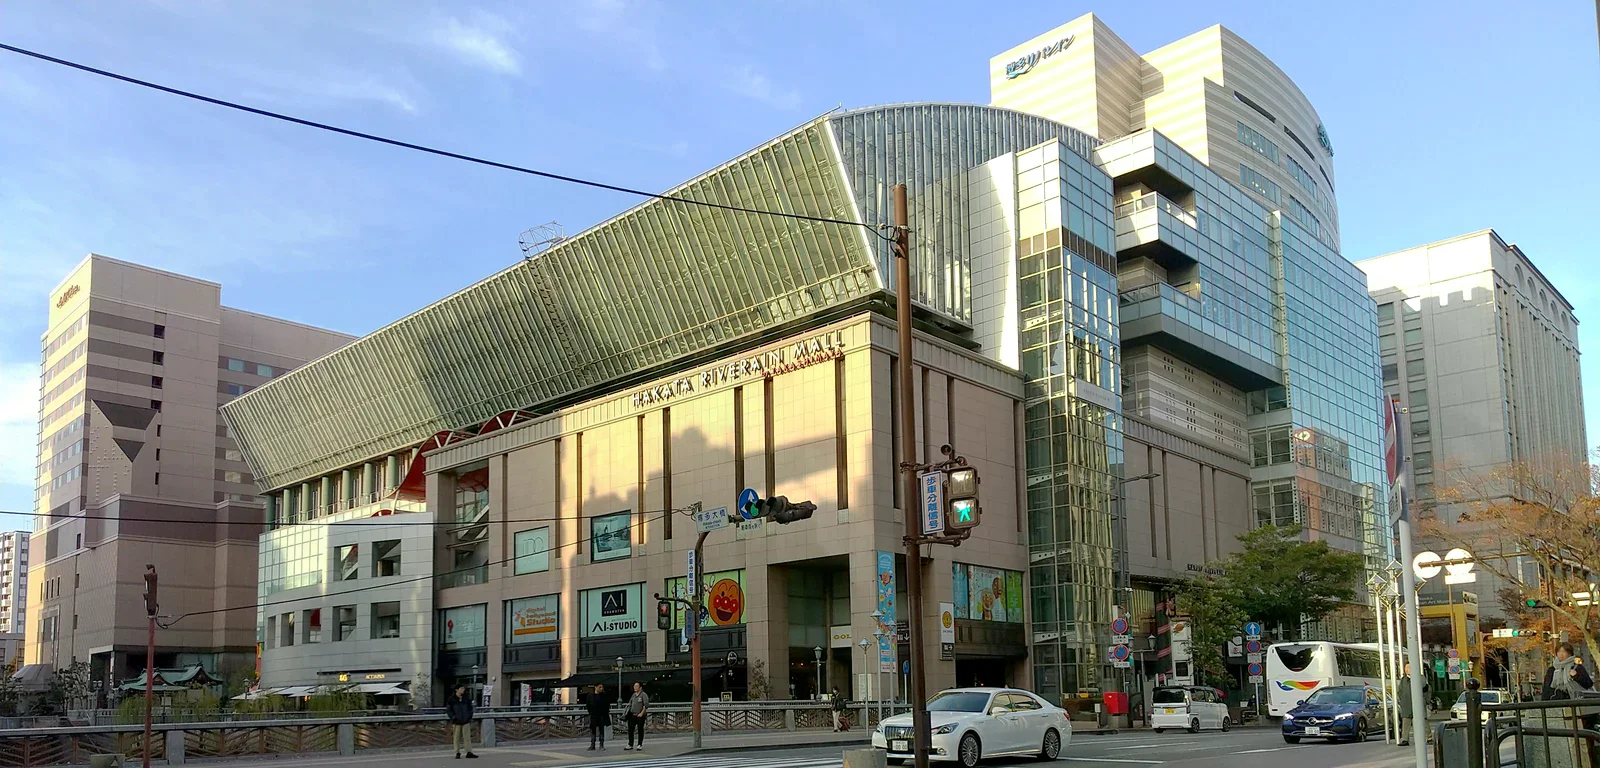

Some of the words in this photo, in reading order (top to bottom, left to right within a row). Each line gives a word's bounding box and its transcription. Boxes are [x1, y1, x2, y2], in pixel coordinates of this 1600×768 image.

[631, 376, 692, 406] HAKATA
[701, 348, 783, 388] RIVERAIN
[793, 330, 844, 359] MALL
[926, 476, 939, 529] 歩車分離信号
[697, 509, 726, 522] 博多大橋
[526, 618, 556, 626] Studio
[592, 620, 638, 632] AI-STUDIO
